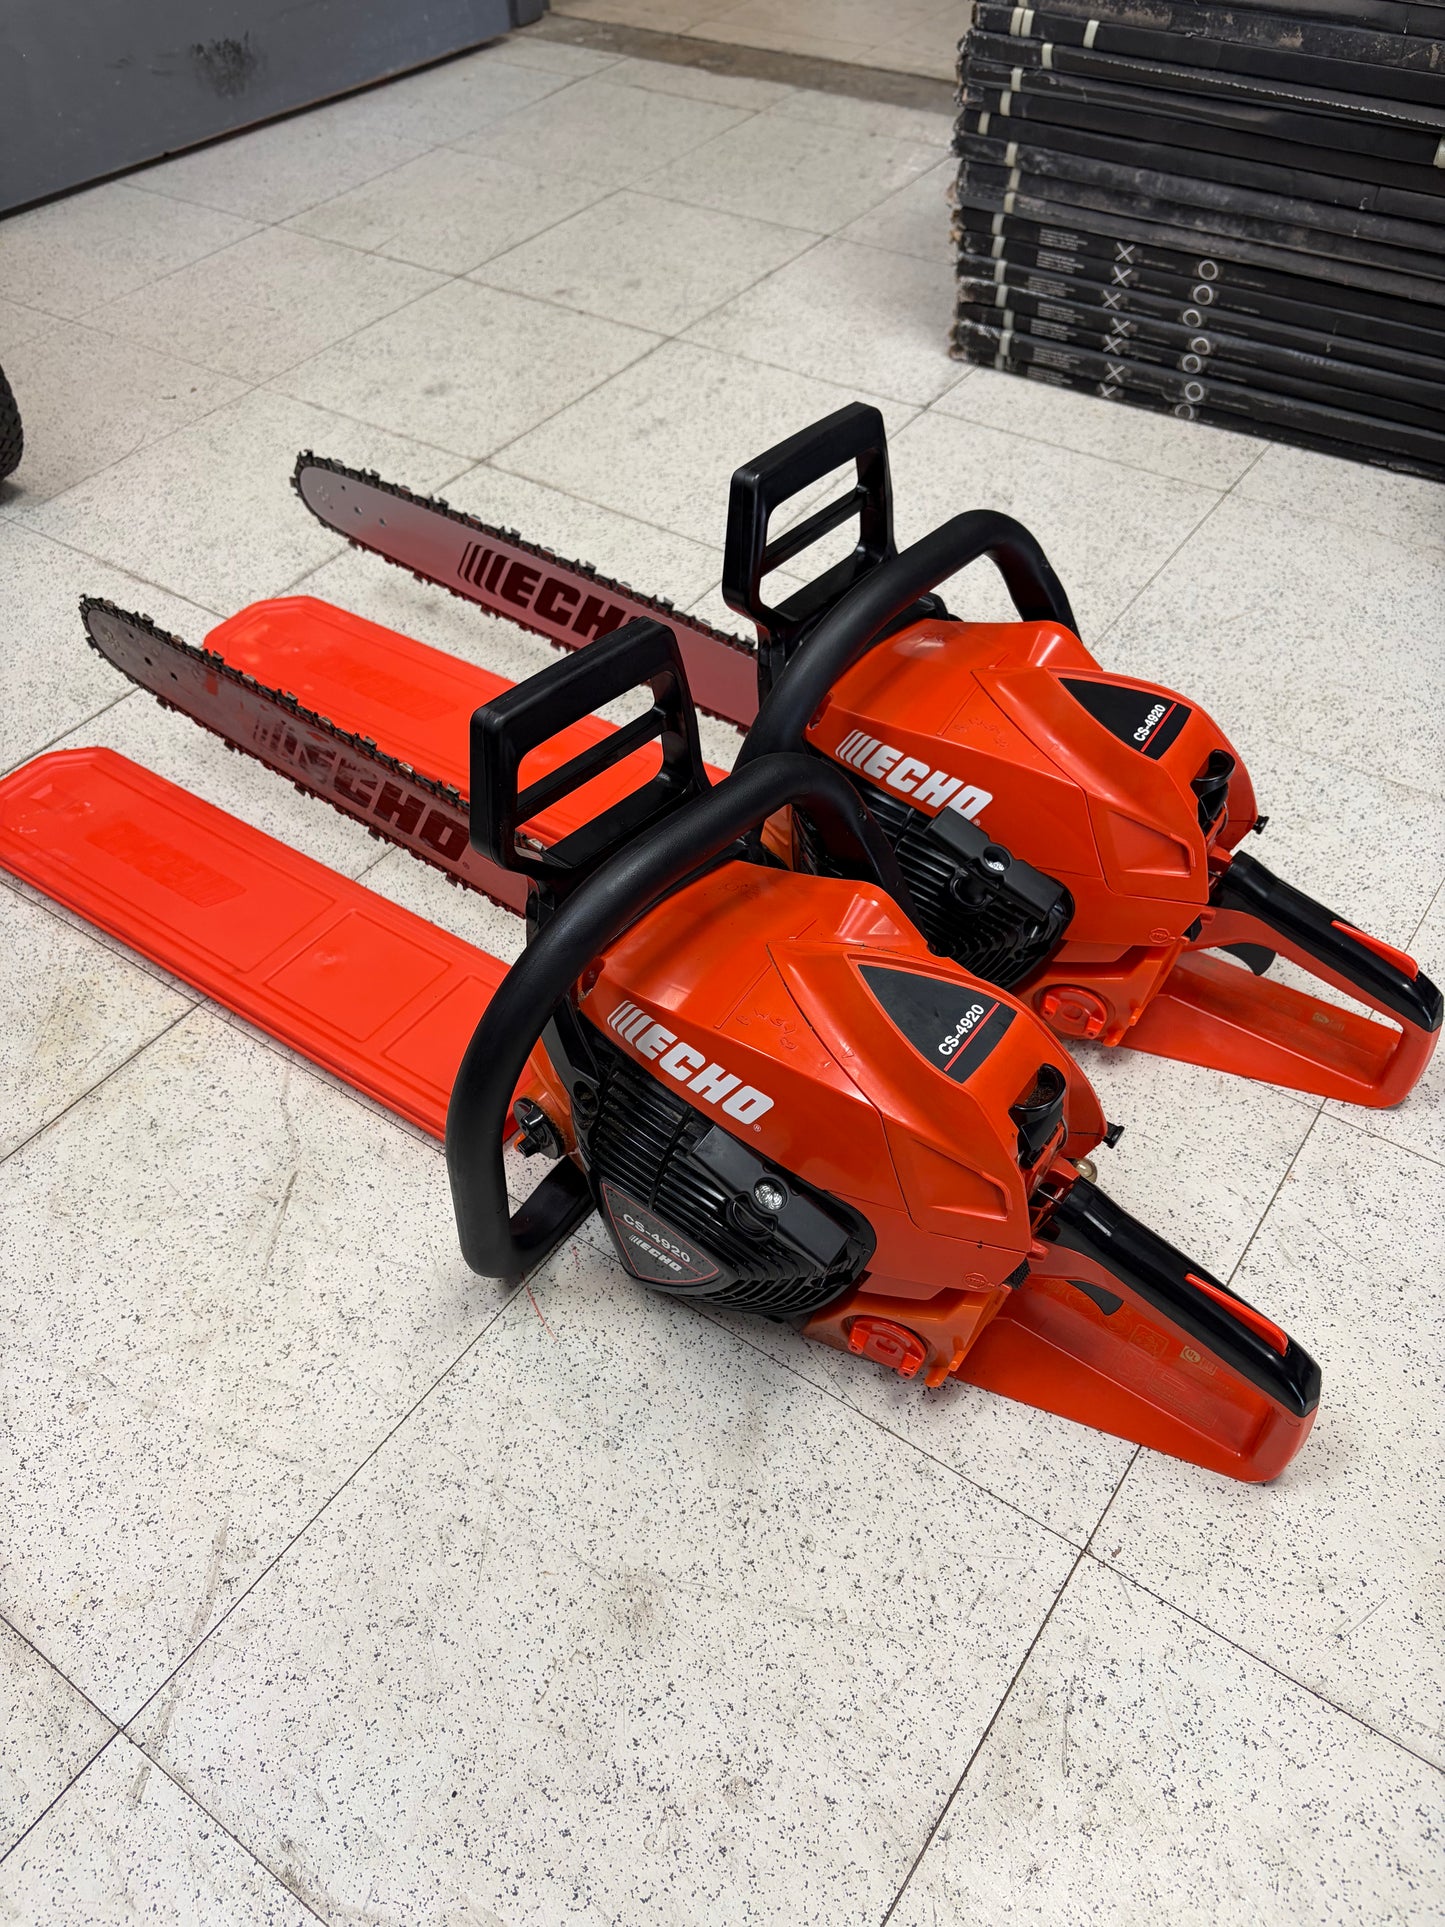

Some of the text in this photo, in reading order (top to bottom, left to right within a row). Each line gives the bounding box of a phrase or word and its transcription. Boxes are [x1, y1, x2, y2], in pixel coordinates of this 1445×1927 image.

[501, 562, 640, 641] ECH
[1133, 704, 1166, 741] CS-4920
[863, 745, 993, 820] ECHO
[938, 1004, 984, 1055] CS-4920
[635, 1023, 775, 1125] ECHO
[623, 1214, 691, 1263] CS-4920
[640, 1241, 682, 1272] ECHO
